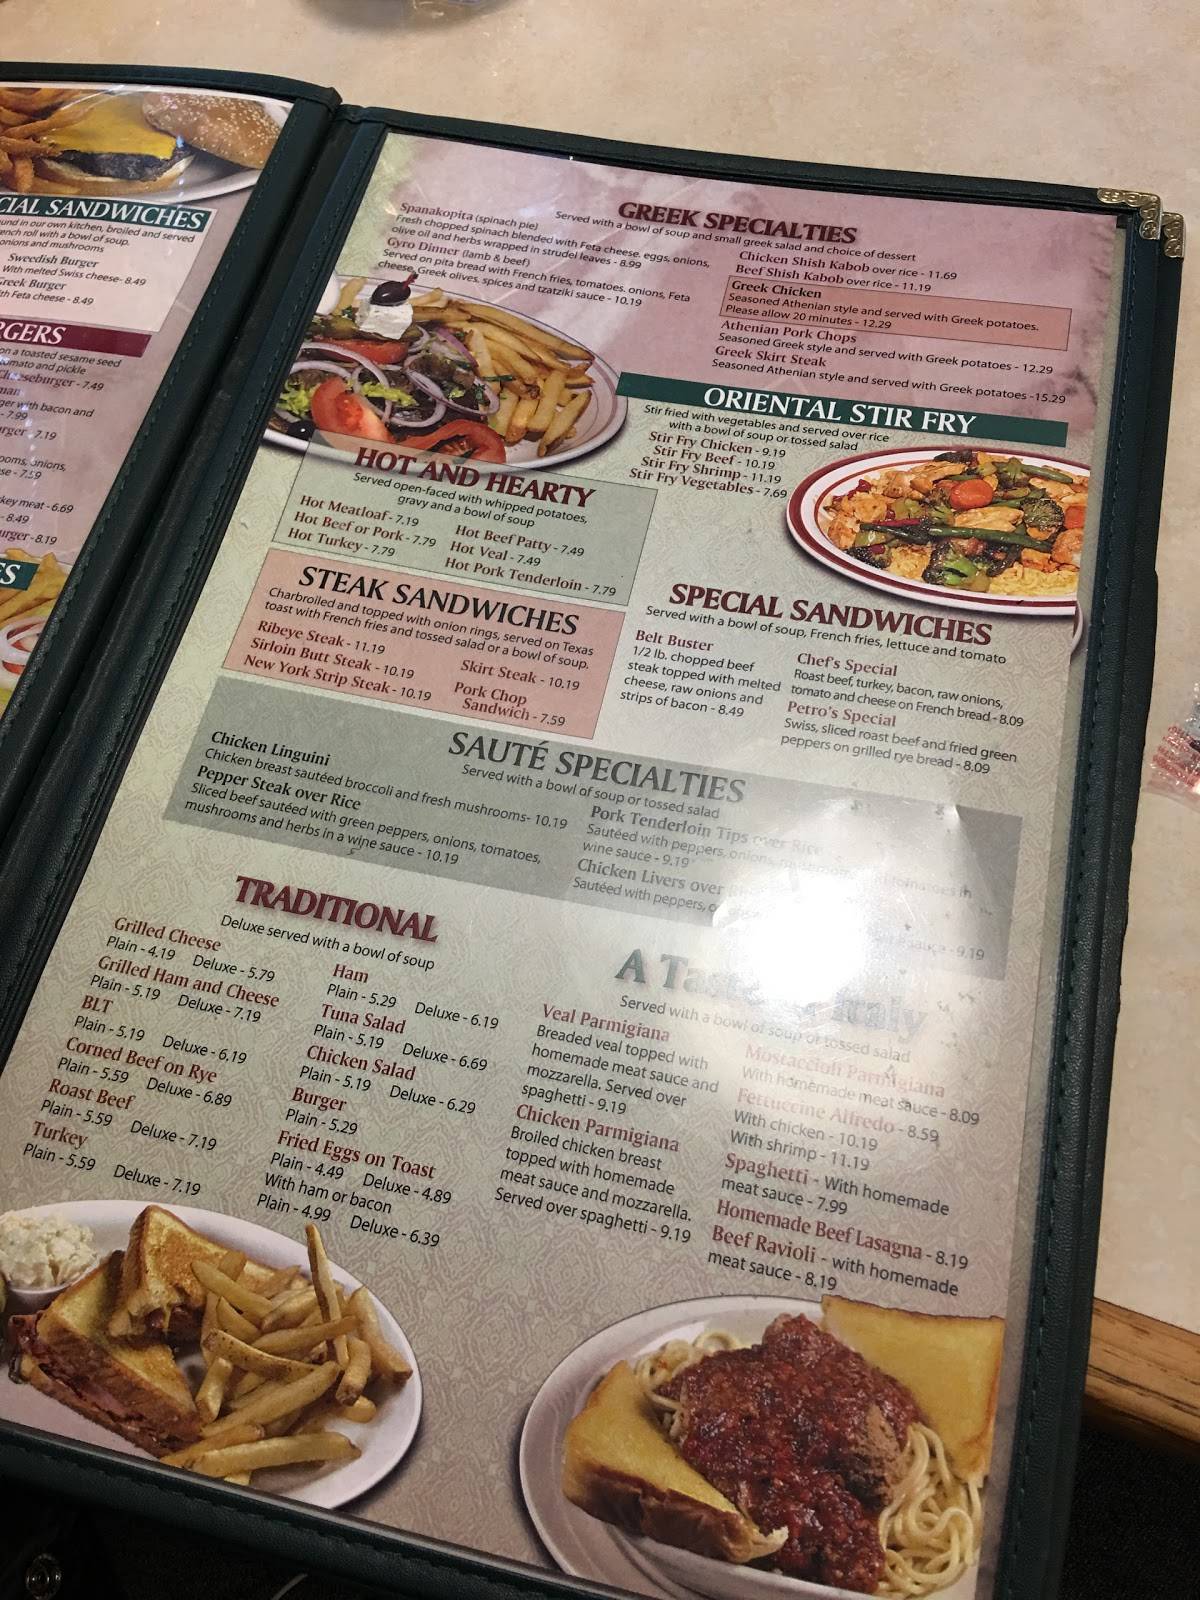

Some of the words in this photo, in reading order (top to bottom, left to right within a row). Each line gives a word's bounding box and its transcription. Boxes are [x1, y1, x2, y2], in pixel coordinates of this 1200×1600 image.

[46, 200, 205, 229] SANDWICHES
[401, 202, 473, 221] Spanakopita
[475, 214, 516, 227] (spinach
[519, 220, 539, 230] pie)
[618, 201, 701, 227] GREEK
[703, 212, 857, 244] SPECIALTIES
[107, 225, 140, 237] broiled
[142, 230, 160, 238] and
[162, 233, 195, 243] served
[555, 211, 590, 224] Served
[593, 216, 614, 228] with
[625, 220, 651, 234] bowl
[653, 224, 664, 235] of
[665, 228, 689, 241] soup
[692, 231, 711, 242] and
[714, 232, 742, 245] small
[743, 237, 772, 249] greek
[774, 240, 802, 251] salad
[805, 243, 824, 254] and
[827, 245, 861, 258] choice
[863, 249, 875, 259] of
[877, 251, 916, 262] dessert
[8, 253, 57, 264] Sweedish
[61, 256, 99, 268] Burger
[388, 237, 415, 249] Gyro
[418, 242, 459, 256] Dinner
[462, 251, 491, 261] (lamb
[503, 256, 530, 267] beef)
[740, 251, 790, 266] Chicken
[791, 255, 827, 269] Shish
[830, 259, 869, 273] Kabob
[872, 266, 897, 276] over
[899, 268, 918, 278] rice
[928, 270, 957, 280] 11.69
[3, 265, 23, 273] With
[25, 267, 56, 276] melted
[59, 269, 84, 279] Swiss
[124, 277, 146, 286] 8.49
[732, 280, 768, 294] Greek
[772, 284, 821, 299] Chicken
[12, 290, 31, 299] Feta
[33, 294, 65, 303] cheese
[73, 297, 94, 305] 8.49
[722, 318, 780, 336] Athenian
[783, 325, 814, 340] Pork
[816, 328, 857, 345] Chops
[726, 304, 759, 317] Please
[762, 308, 791, 319] allow
[794, 312, 806, 322] 20
[808, 314, 852, 326] minutes
[863, 318, 891, 329] 12.29
[21, 349, 57, 359] toasted
[58, 355, 95, 364] sesame
[96, 359, 121, 367] seed
[56, 366, 86, 375] pickle
[82, 381, 104, 391] 7.49
[40, 403, 71, 414] bacon
[73, 408, 94, 417] and
[703, 387, 841, 421] ORIENTAL
[849, 403, 912, 426] STIR
[922, 411, 976, 434] FRY
[649, 431, 674, 444] Stir
[676, 435, 697, 449] Fry
[699, 437, 753, 455] Chicken
[762, 446, 786, 459] 9.19
[354, 446, 417, 476] HOT
[418, 461, 480, 488] AND
[486, 473, 596, 509] HEARTY
[52, 503, 74, 514] 6.69
[300, 494, 325, 509] Hot
[328, 500, 388, 522] Meatloaf
[395, 514, 419, 527] 7.19
[35, 534, 57, 545] 8.19
[445, 556, 470, 572] Hot
[474, 562, 505, 579] Pork
[508, 569, 582, 592] Tenderloin
[592, 584, 616, 597] 7.79
[299, 566, 388, 601] STEAK
[393, 584, 579, 636] SANDWICHES
[670, 583, 784, 618] SPECIAL
[790, 599, 993, 646] SANDWICHES
[258, 620, 303, 639] Ribeye
[307, 628, 344, 647] Steak
[354, 640, 385, 655] 11.19
[636, 629, 664, 645] Belt
[667, 634, 714, 651] Buster
[461, 659, 497, 677] Skirt
[498, 666, 537, 684] Steak
[548, 675, 580, 691] 10.19
[797, 652, 842, 671] Chef's
[845, 659, 898, 678] Special
[463, 697, 531, 722] Sandwich
[540, 713, 566, 727] 7.59
[620, 690, 653, 708] strips
[656, 693, 668, 708] of
[671, 696, 708, 713] bacon
[718, 704, 745, 718] 8.49
[787, 701, 840, 720] Petro's
[843, 708, 896, 727] Special
[212, 730, 268, 752] Chicken
[271, 743, 331, 767] Linguini
[448, 731, 549, 771] SAUTÉ
[555, 751, 746, 802] SPECIALTIES
[197, 765, 250, 788] Pepper
[250, 775, 291, 796] Steak
[296, 788, 327, 803] over
[330, 793, 361, 811] Rice
[236, 875, 439, 943] TRADITIONAL
[114, 916, 164, 939] Grilled
[169, 928, 221, 952] Cheese
[107, 936, 138, 953] Plain
[148, 946, 176, 960] 4.19
[192, 954, 238, 975] Deluxe
[248, 967, 275, 982] 5.79
[333, 964, 369, 984] Ham
[82, 994, 113, 1014] BLT
[322, 1004, 358, 1025] Tuna
[362, 1013, 406, 1034] Salad
[543, 1004, 577, 1025] Veal
[580, 1010, 670, 1043] Parmigiana
[292, 1087, 347, 1112] Burger
[33, 1121, 88, 1150] Turkey
[517, 1103, 580, 1132] Chicken
[586, 1116, 679, 1153] Parmigiana
[278, 1130, 320, 1152] Fried
[322, 1141, 360, 1164] Eggs
[364, 1152, 386, 1168] on
[392, 1154, 436, 1179] Toast
[265, 1172, 296, 1191] With
[299, 1180, 329, 1200] ham
[332, 1190, 348, 1201] or
[350, 1192, 392, 1214] bacon
[725, 1153, 808, 1186] Spaghetti
[824, 1175, 859, 1195] With
[863, 1182, 949, 1216] homemade
[712, 1224, 750, 1248] Beef
[755, 1233, 816, 1264] Ravioli
[716, 1199, 812, 1236] Homemade
[816, 1220, 854, 1244] Beef
[857, 1229, 922, 1260] Lasagna
[935, 1249, 968, 1269] 8.19
